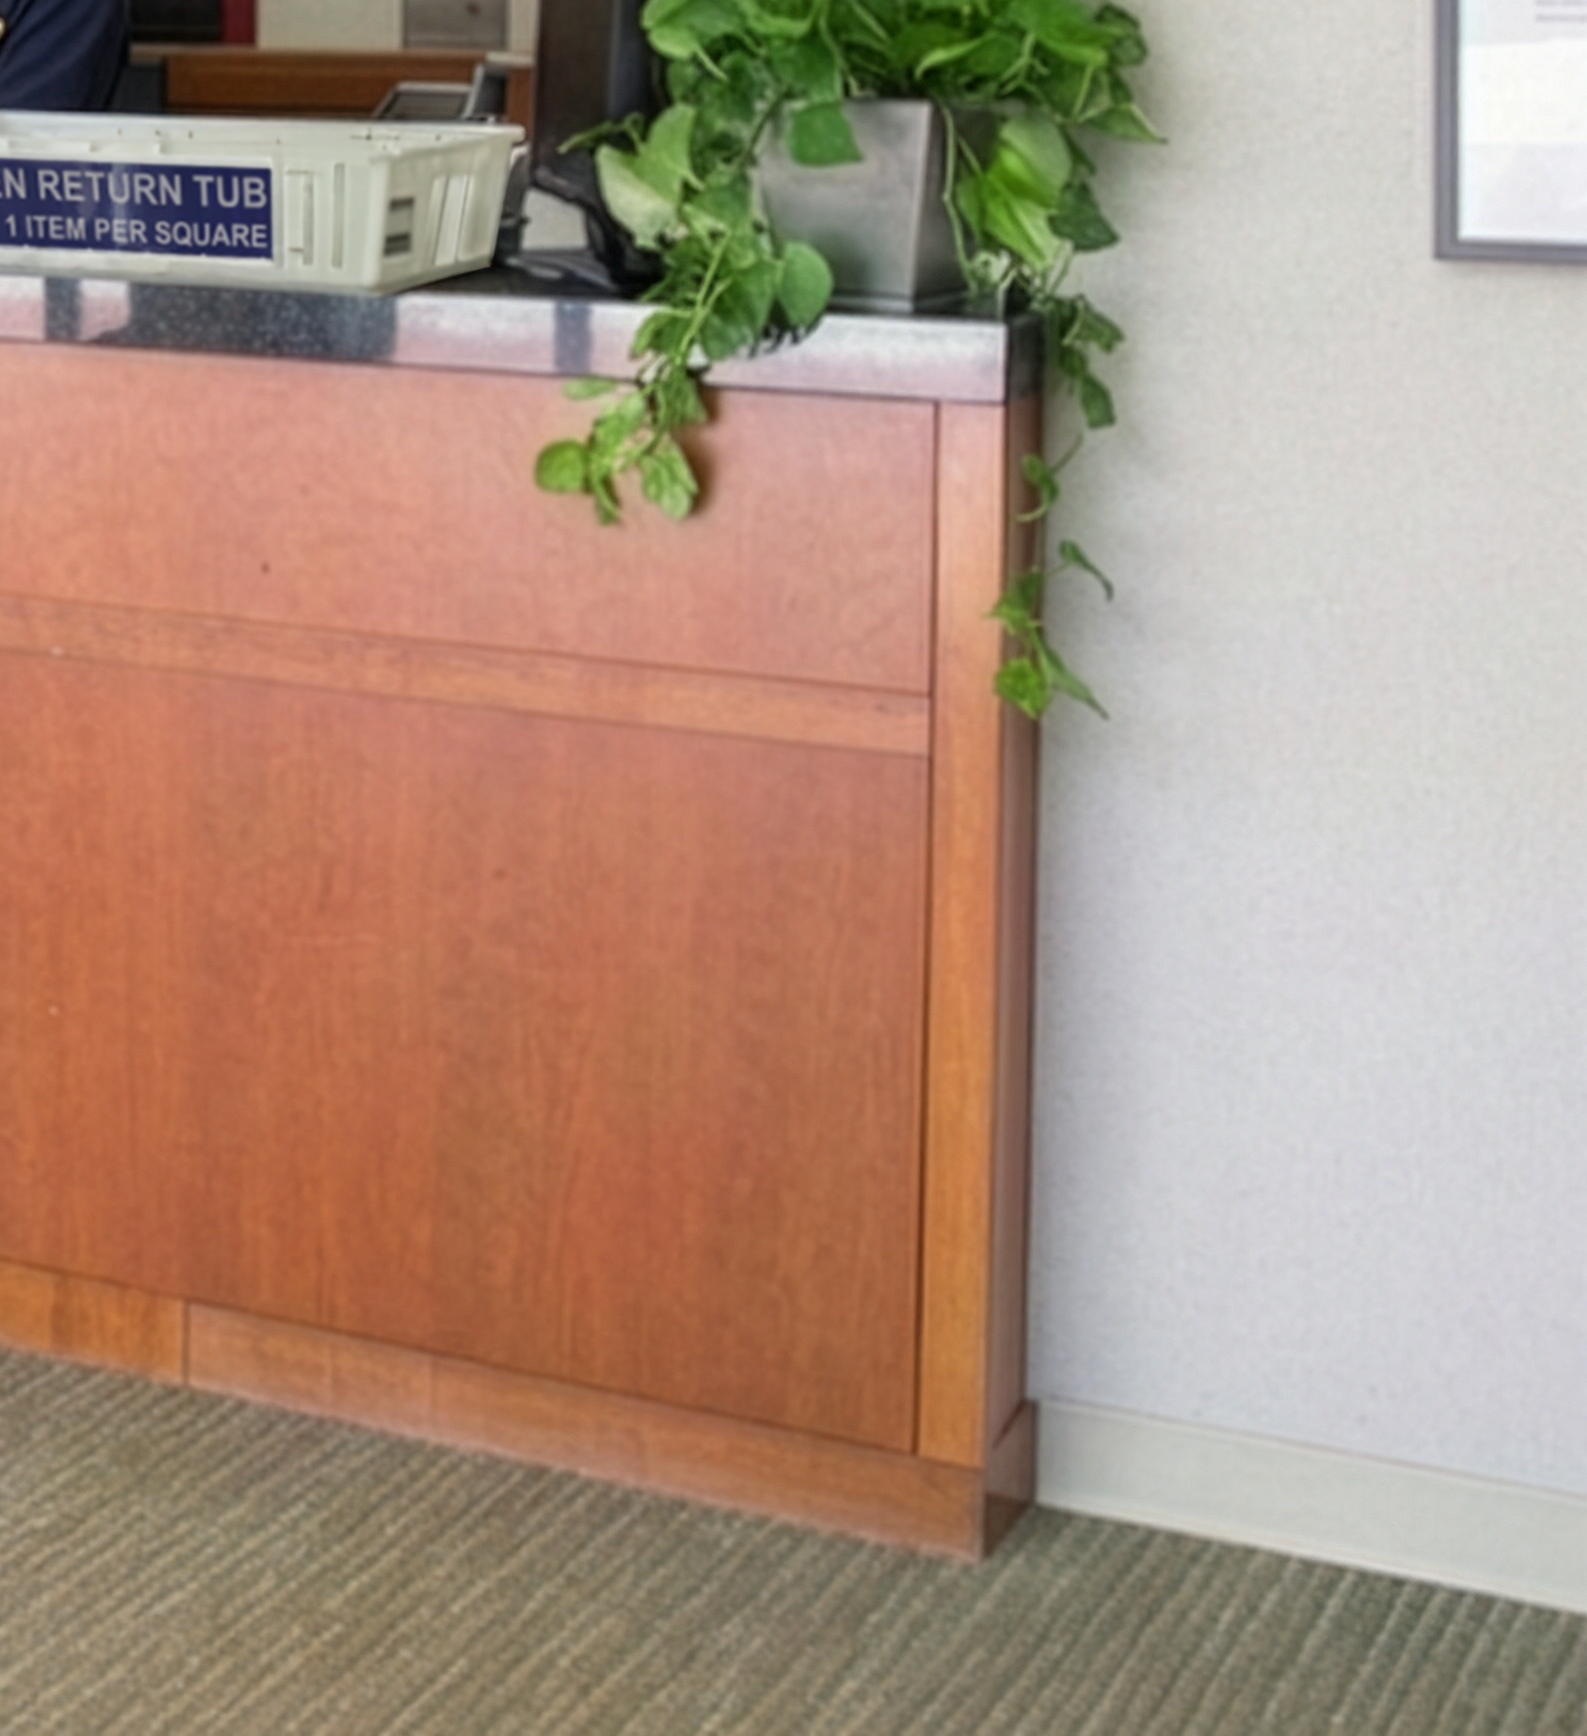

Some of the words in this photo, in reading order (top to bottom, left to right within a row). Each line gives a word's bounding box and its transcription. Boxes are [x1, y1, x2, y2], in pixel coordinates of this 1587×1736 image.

[37, 168, 182, 207] RETURN
[192, 174, 268, 209] TUB
[5, 215, 17, 237] 1
[26, 215, 87, 240] ITEM
[94, 218, 148, 244] PER
[154, 220, 268, 249] SQUARE
